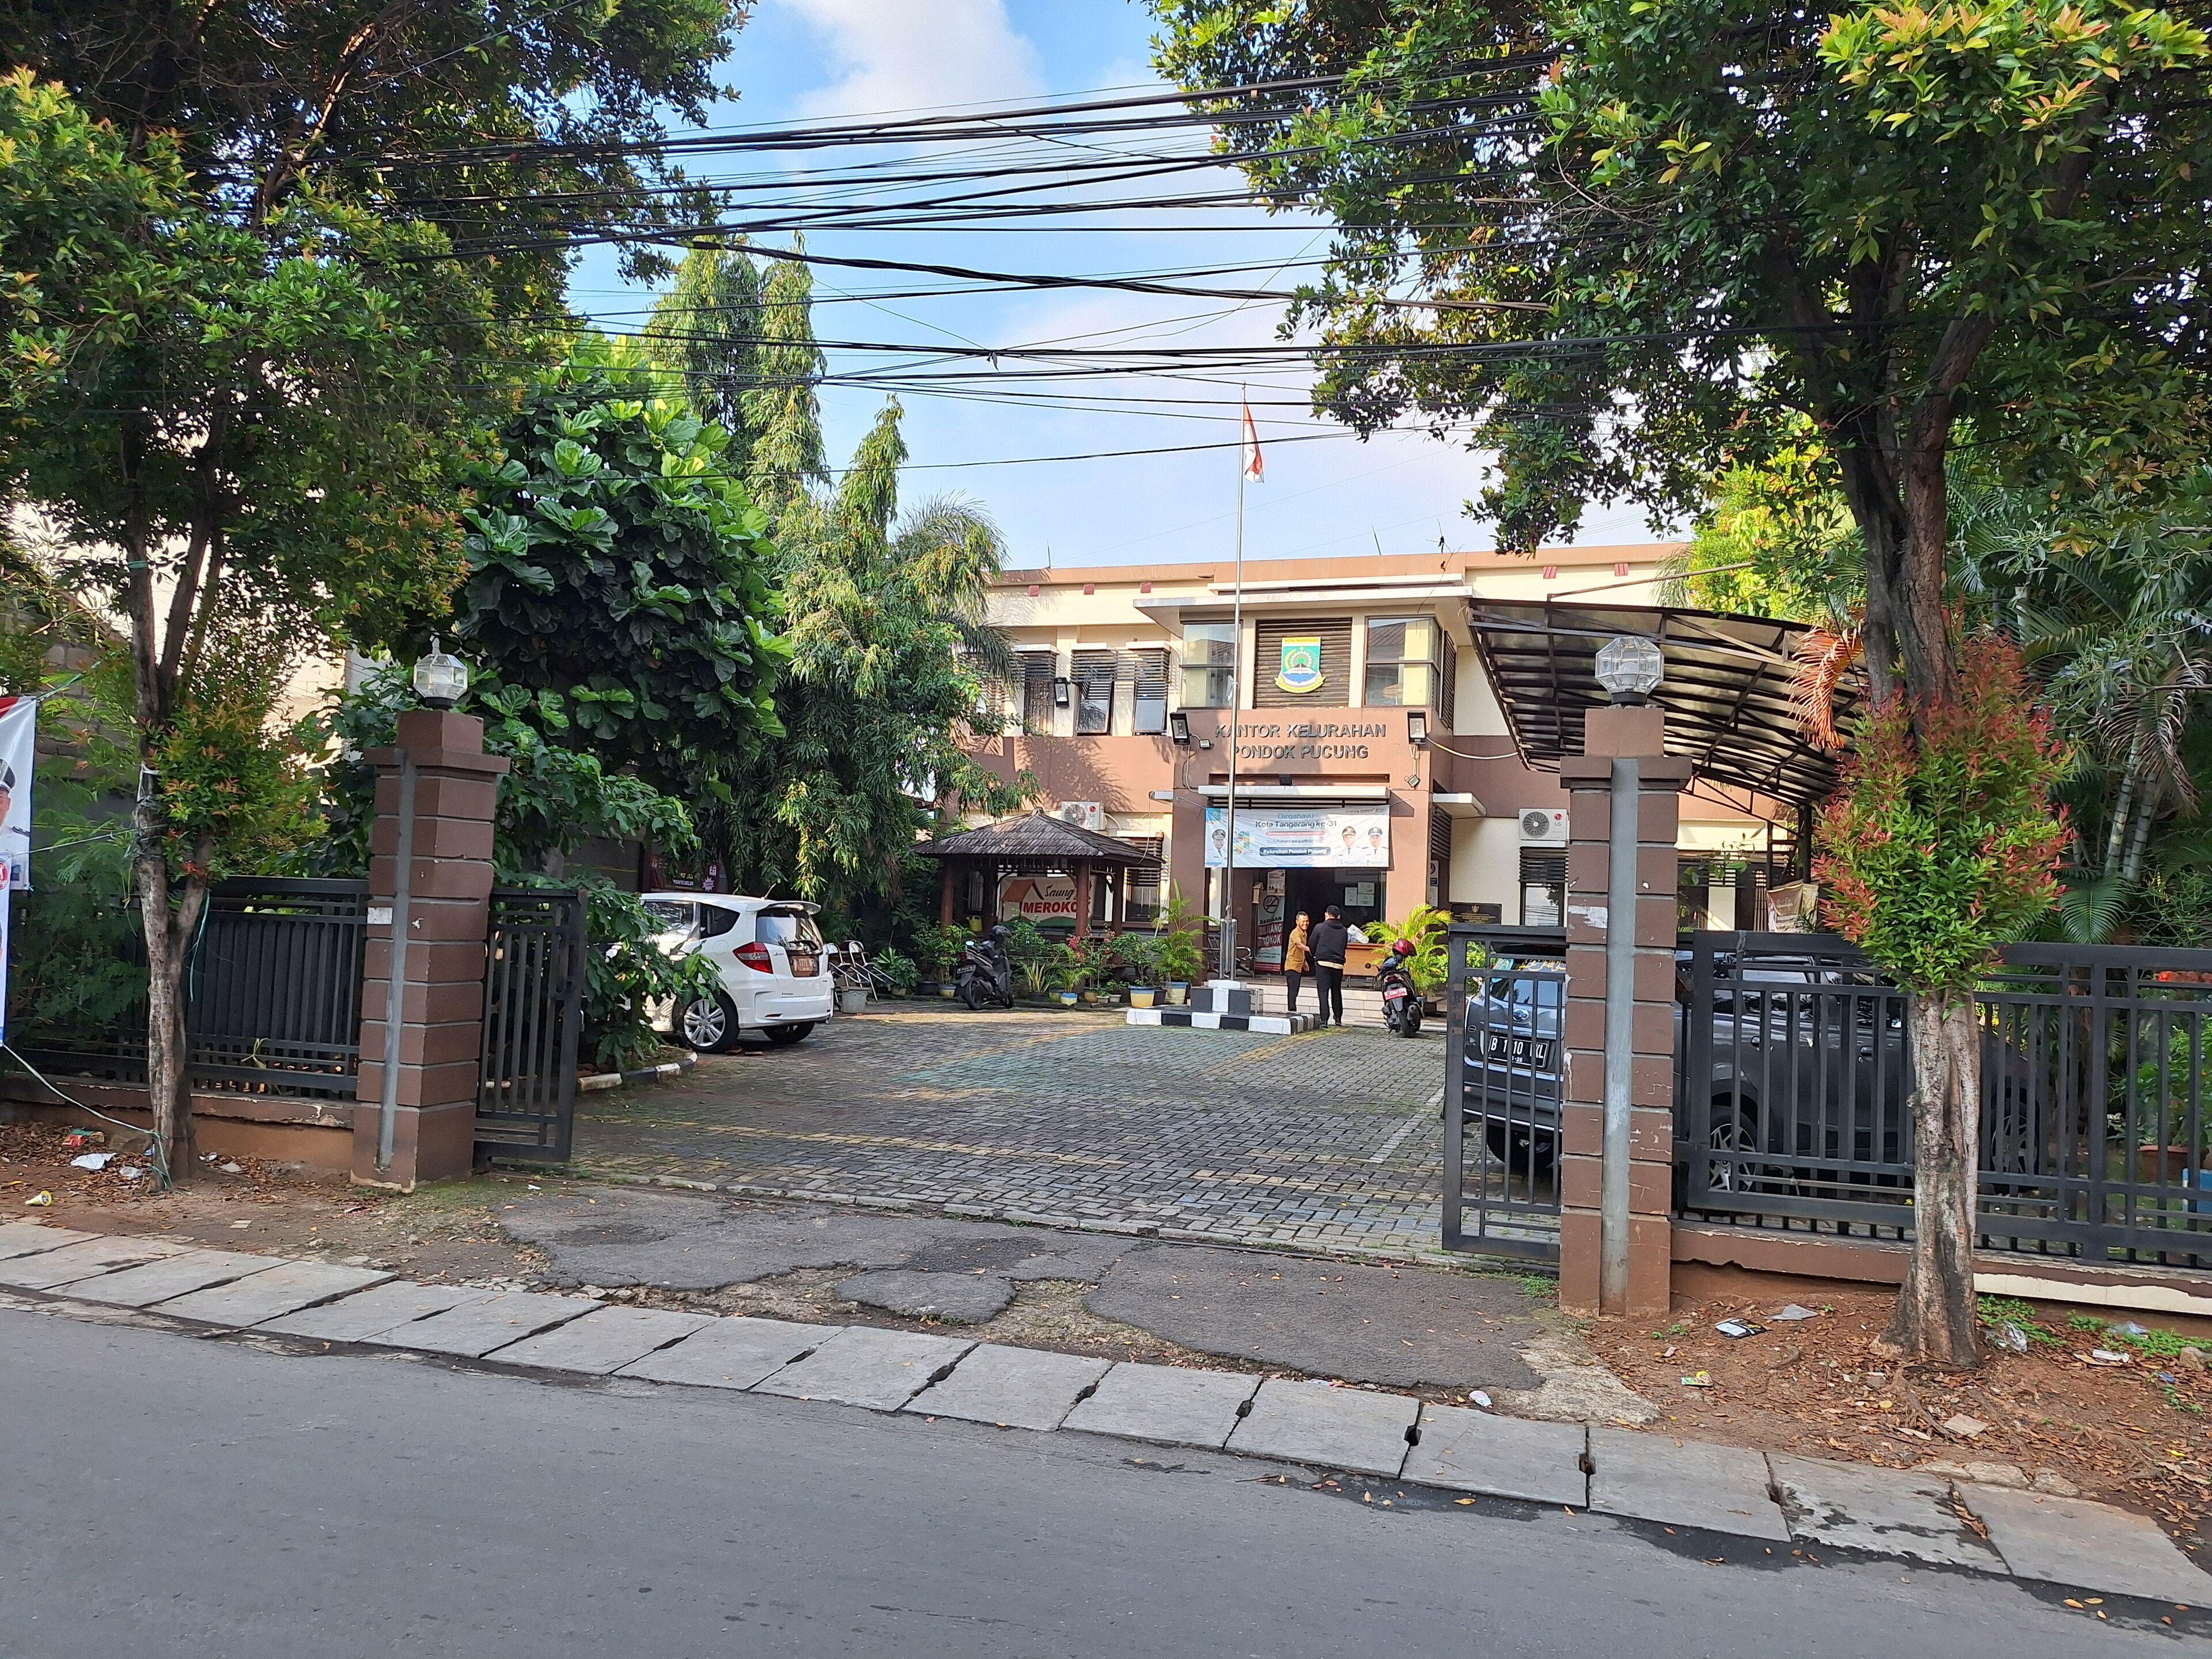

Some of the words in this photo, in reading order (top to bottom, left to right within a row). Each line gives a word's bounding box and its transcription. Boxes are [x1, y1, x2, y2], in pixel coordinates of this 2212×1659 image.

[1215, 724, 1280, 737] KANTOR
[1286, 724, 1387, 737] KELURAHAN
[1300, 744, 1369, 759] PUCUNG
[1044, 884, 1075, 900] Saung
[1490, 1037, 1498, 1051] B
[1503, 1039, 1524, 1055] 110
